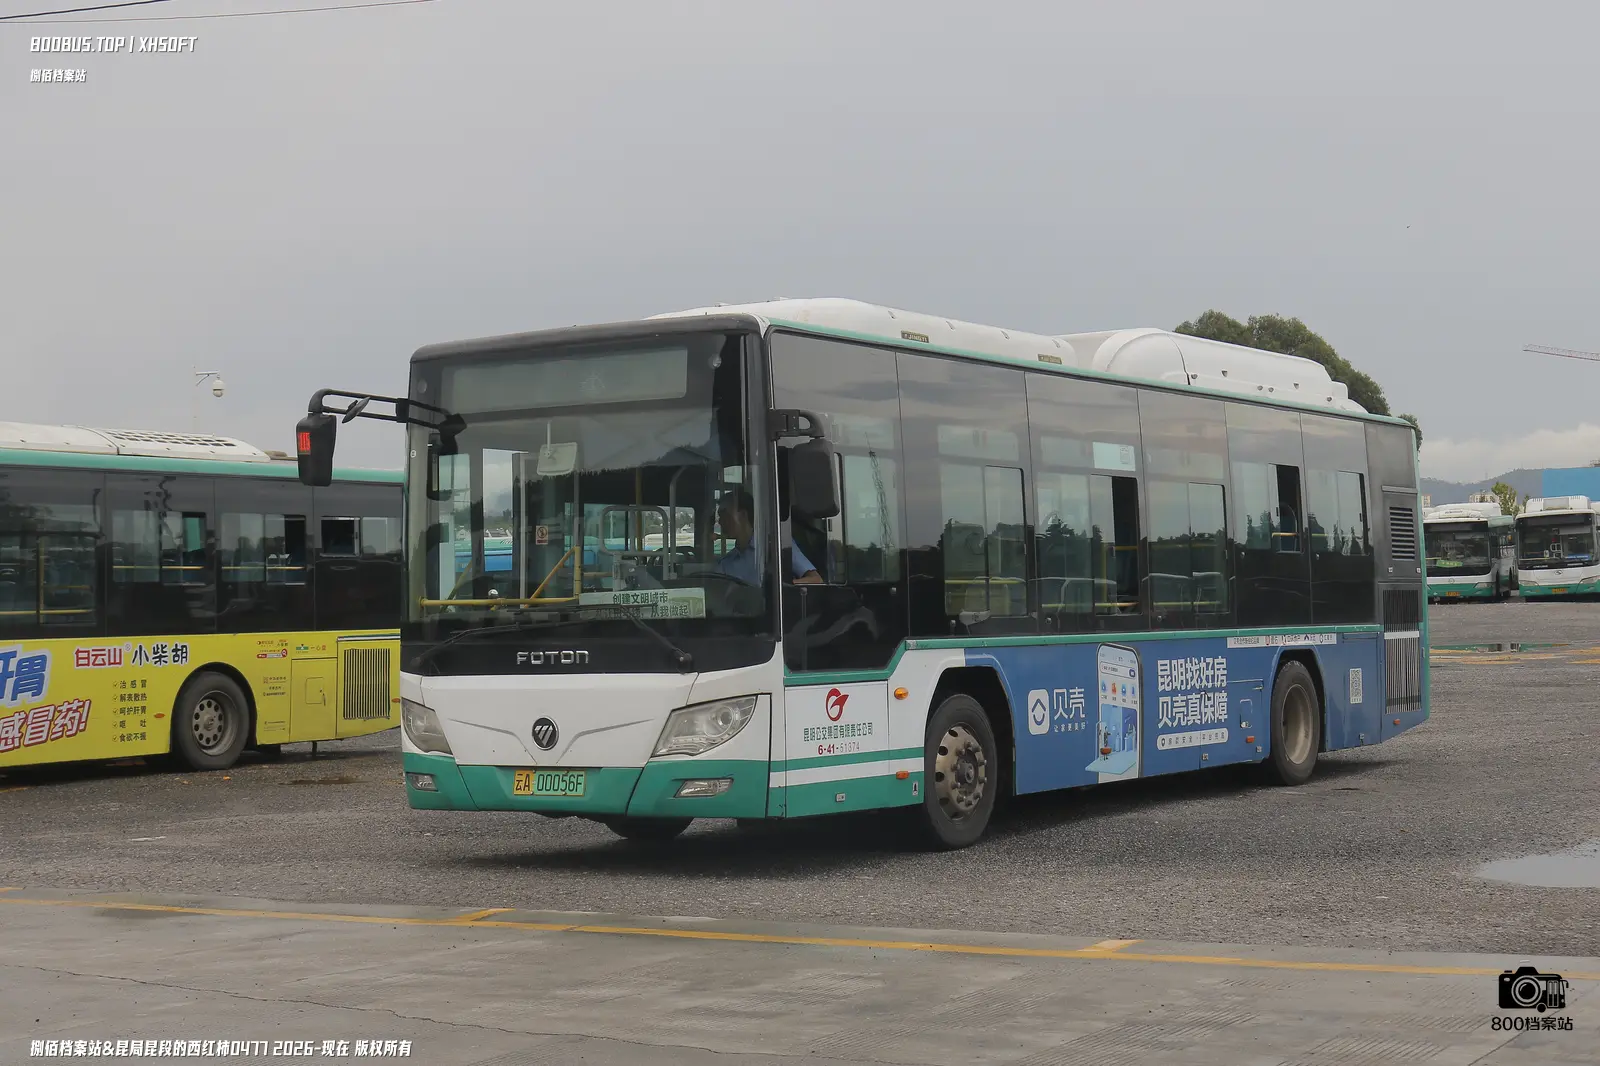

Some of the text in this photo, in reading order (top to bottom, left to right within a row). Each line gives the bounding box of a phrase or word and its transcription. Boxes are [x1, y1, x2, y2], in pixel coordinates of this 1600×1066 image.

[74, 643, 189, 667] 白云山 小柴胡
[516, 650, 590, 666] FOTON
[1157, 655, 1228, 693] 昆明找好房
[1053, 686, 1086, 721] 贝壳
[1157, 690, 1228, 729] 贝壳真保障
[803, 722, 873, 742] 昆明公交集团有限责任公司
